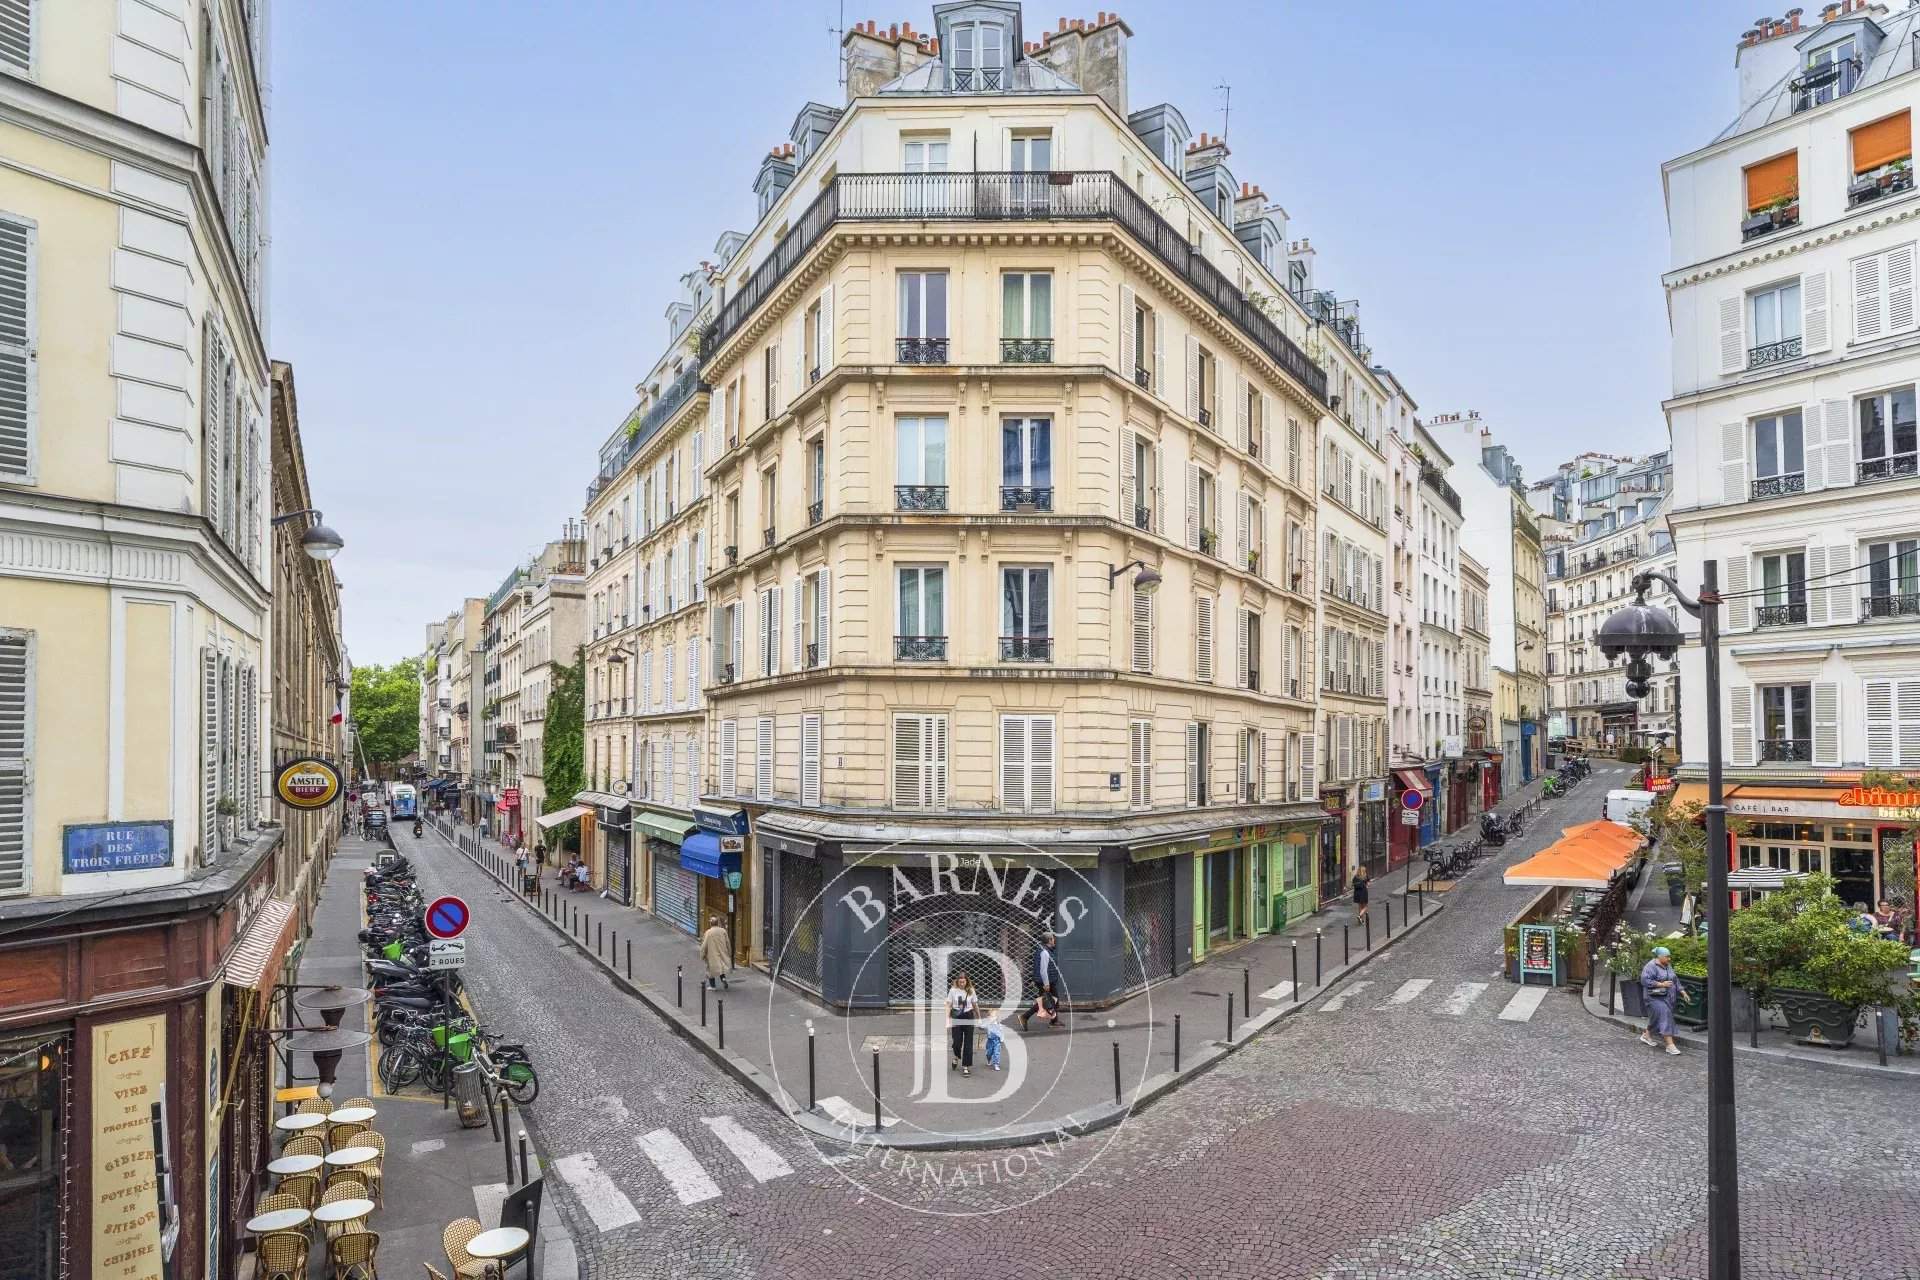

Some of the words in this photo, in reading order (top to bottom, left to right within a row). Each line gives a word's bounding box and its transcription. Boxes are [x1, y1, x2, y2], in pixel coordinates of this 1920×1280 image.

[290, 777, 326, 785] AMSTEL
[105, 830, 136, 841] RUE
[107, 843, 134, 853] DES
[71, 856, 111, 868] TROIS
[115, 852, 166, 866] FRÈRES
[439, 957, 465, 965] ROUES
[107, 1046, 152, 1065] CAFÉ
[124, 1104, 138, 1114] DE
[123, 1170, 136, 1180] DE
